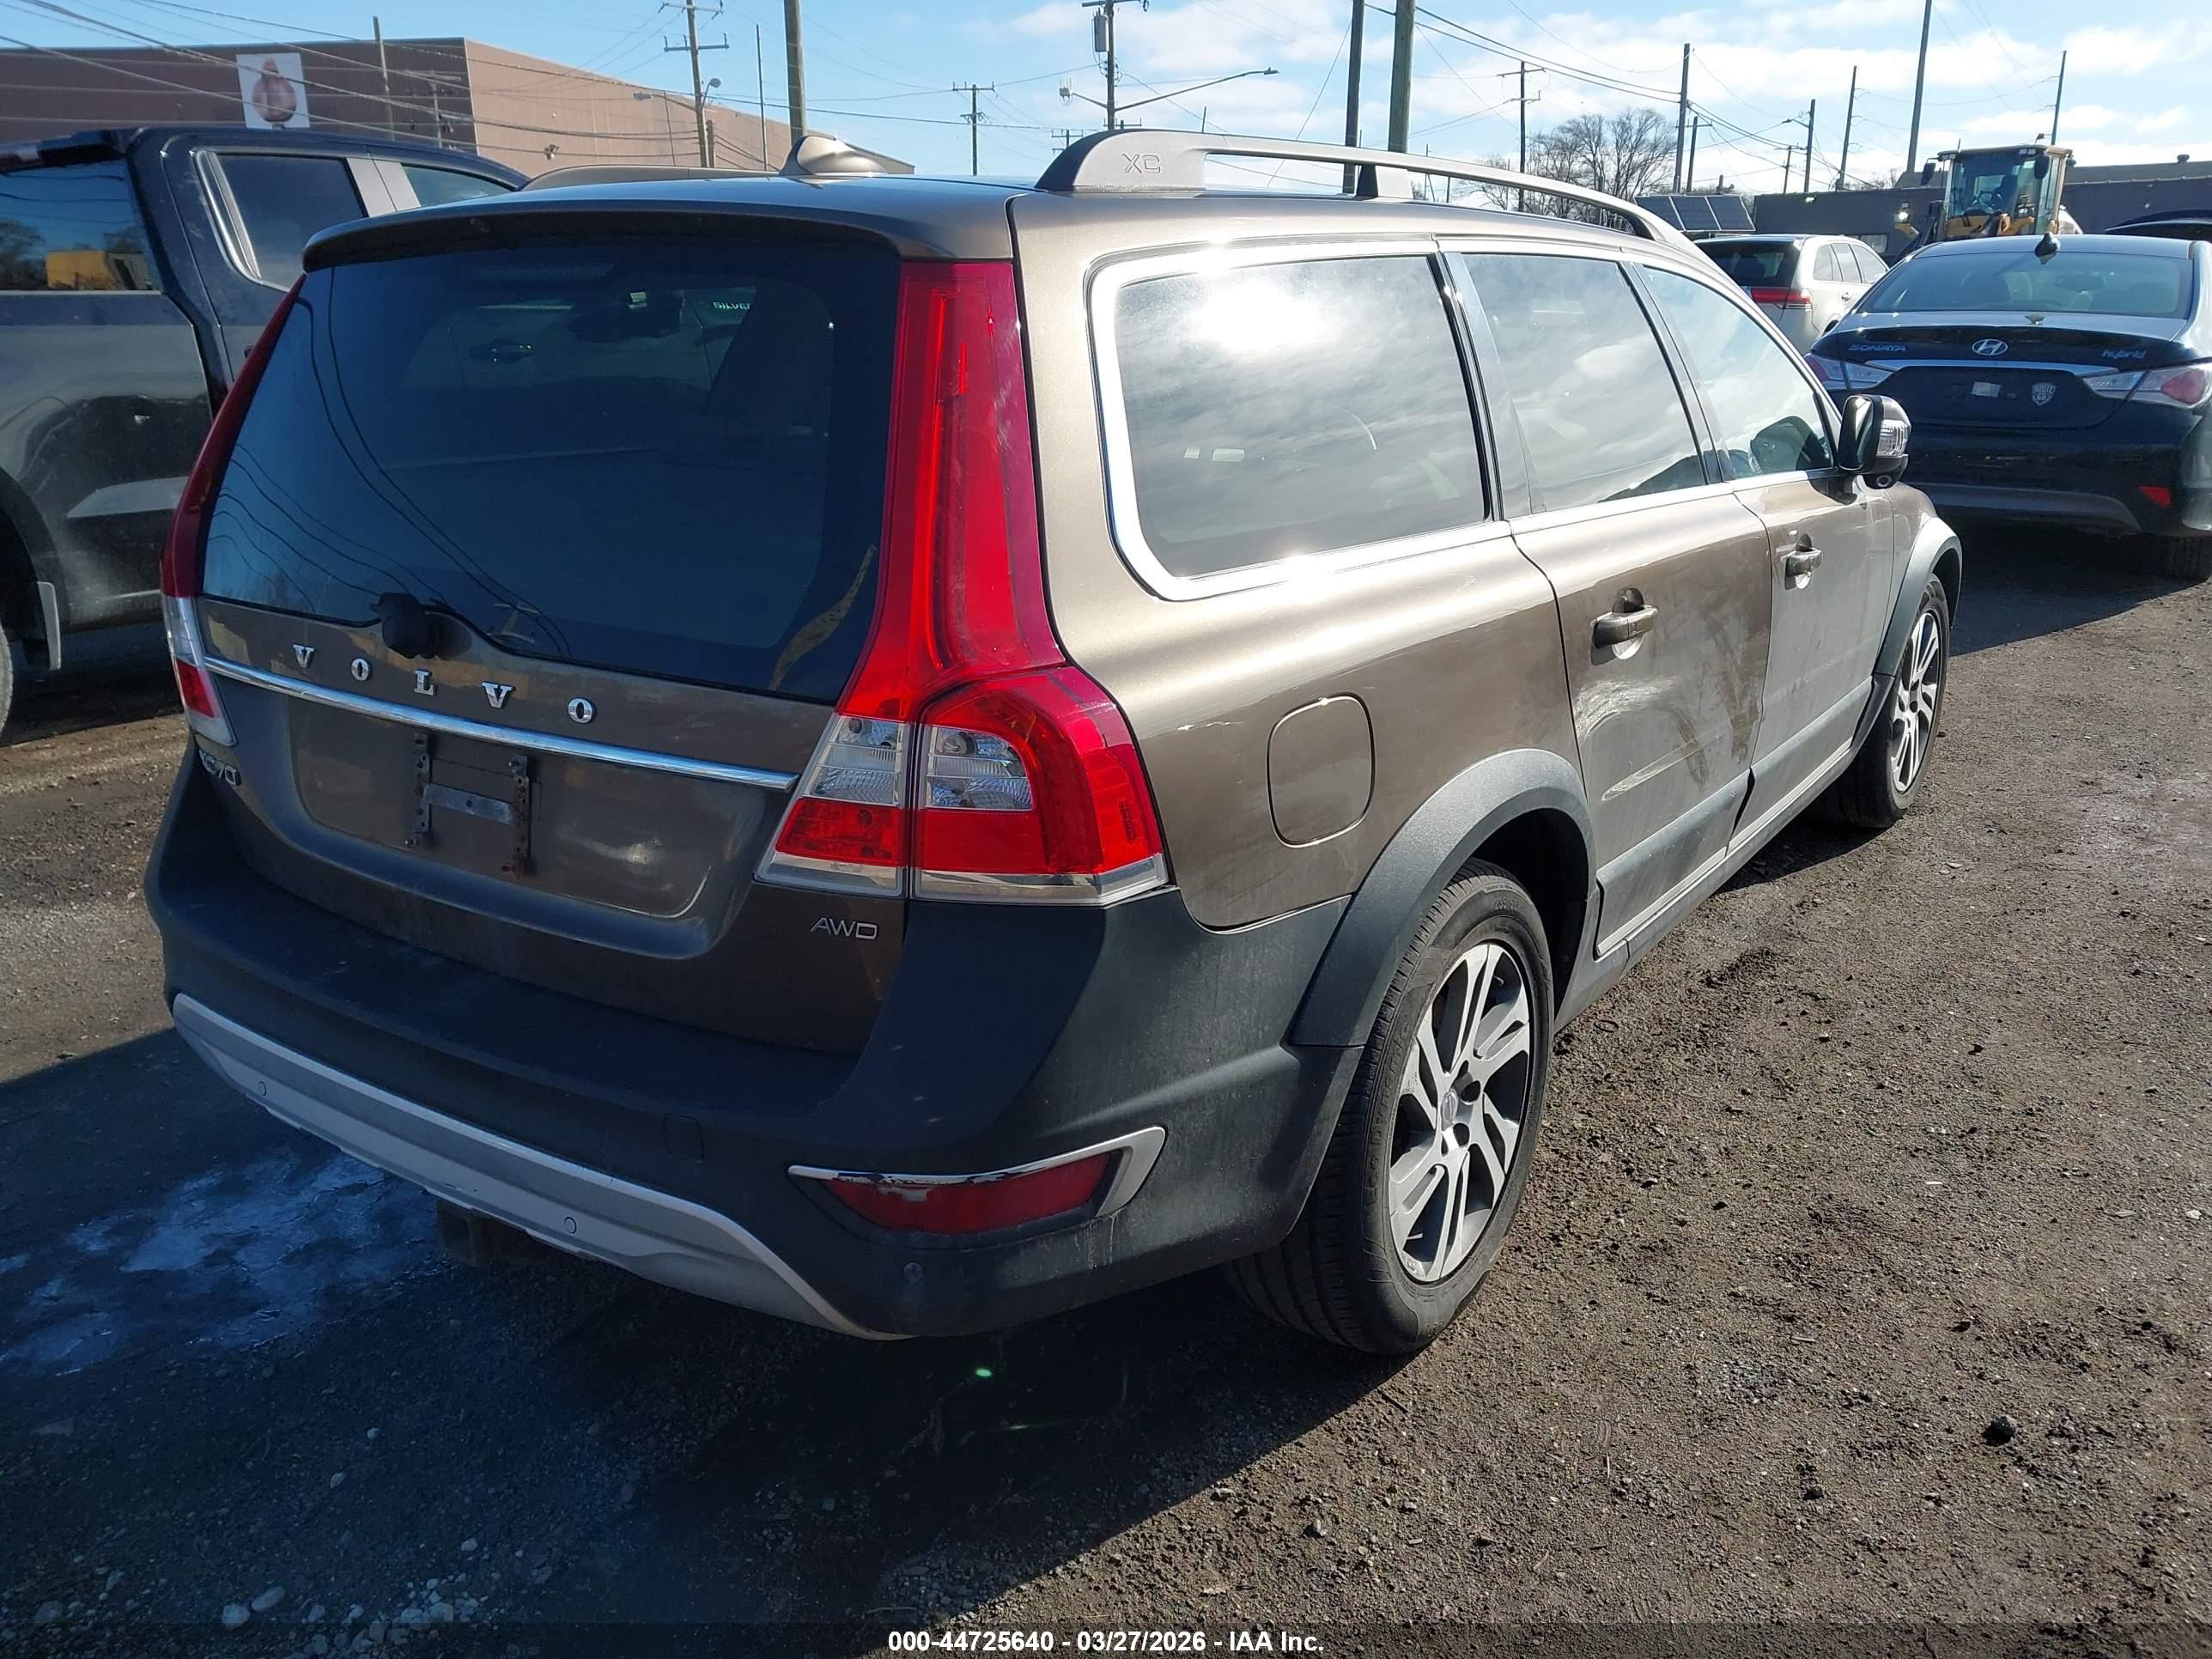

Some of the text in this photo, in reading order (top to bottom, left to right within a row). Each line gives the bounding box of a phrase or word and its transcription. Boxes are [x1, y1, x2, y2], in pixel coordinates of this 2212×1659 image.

[1121, 153, 1161, 174] XC
[292, 643, 597, 724] VOLVO
[810, 916, 878, 940] AWD
